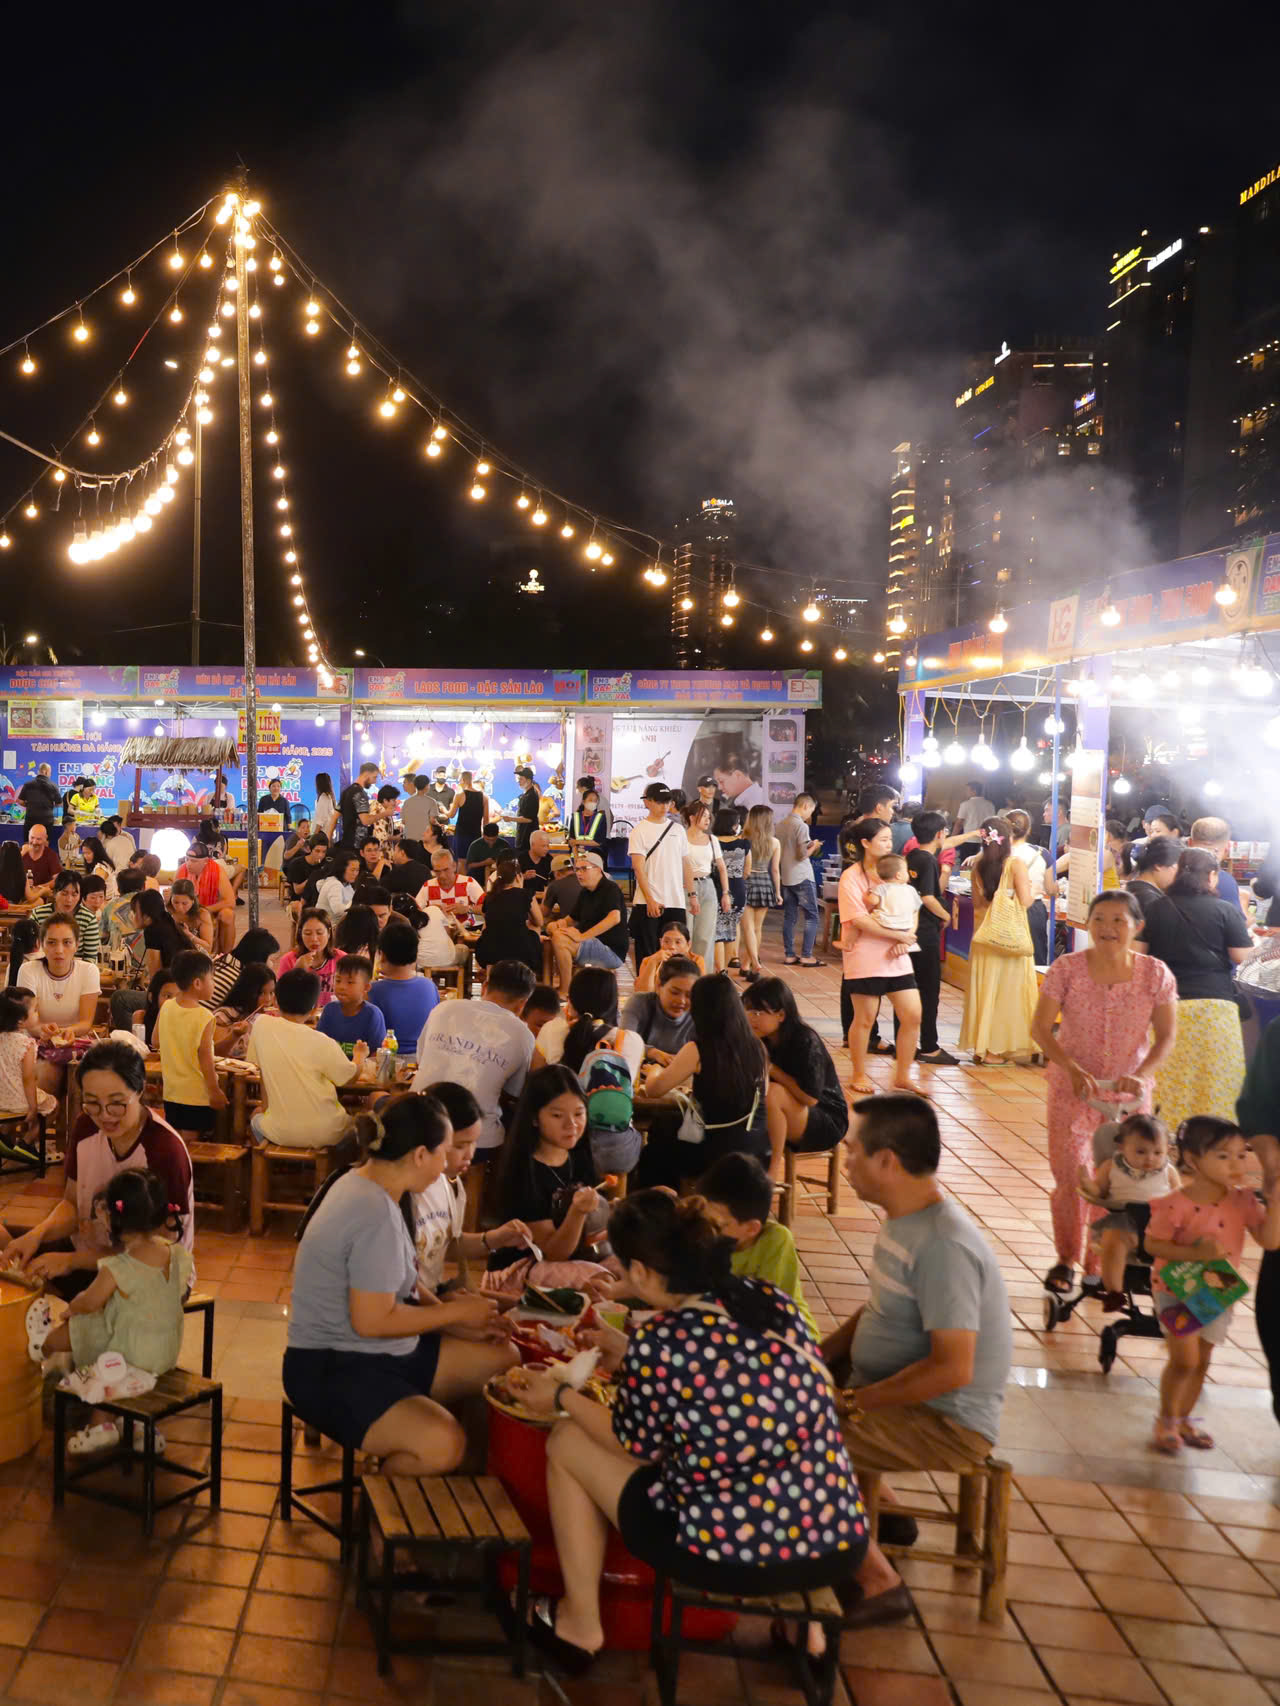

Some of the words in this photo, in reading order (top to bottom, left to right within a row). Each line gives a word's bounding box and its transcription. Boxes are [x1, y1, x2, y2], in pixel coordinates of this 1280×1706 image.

[415, 681, 440, 693] LAOS
[442, 681, 468, 693] FOOD
[477, 680, 497, 696] ĐẶC
[501, 679, 522, 694] SẢN
[524, 681, 544, 694] LÀO
[259, 712, 280, 731] LIÊN
[429, 1032, 474, 1050] GRAND
